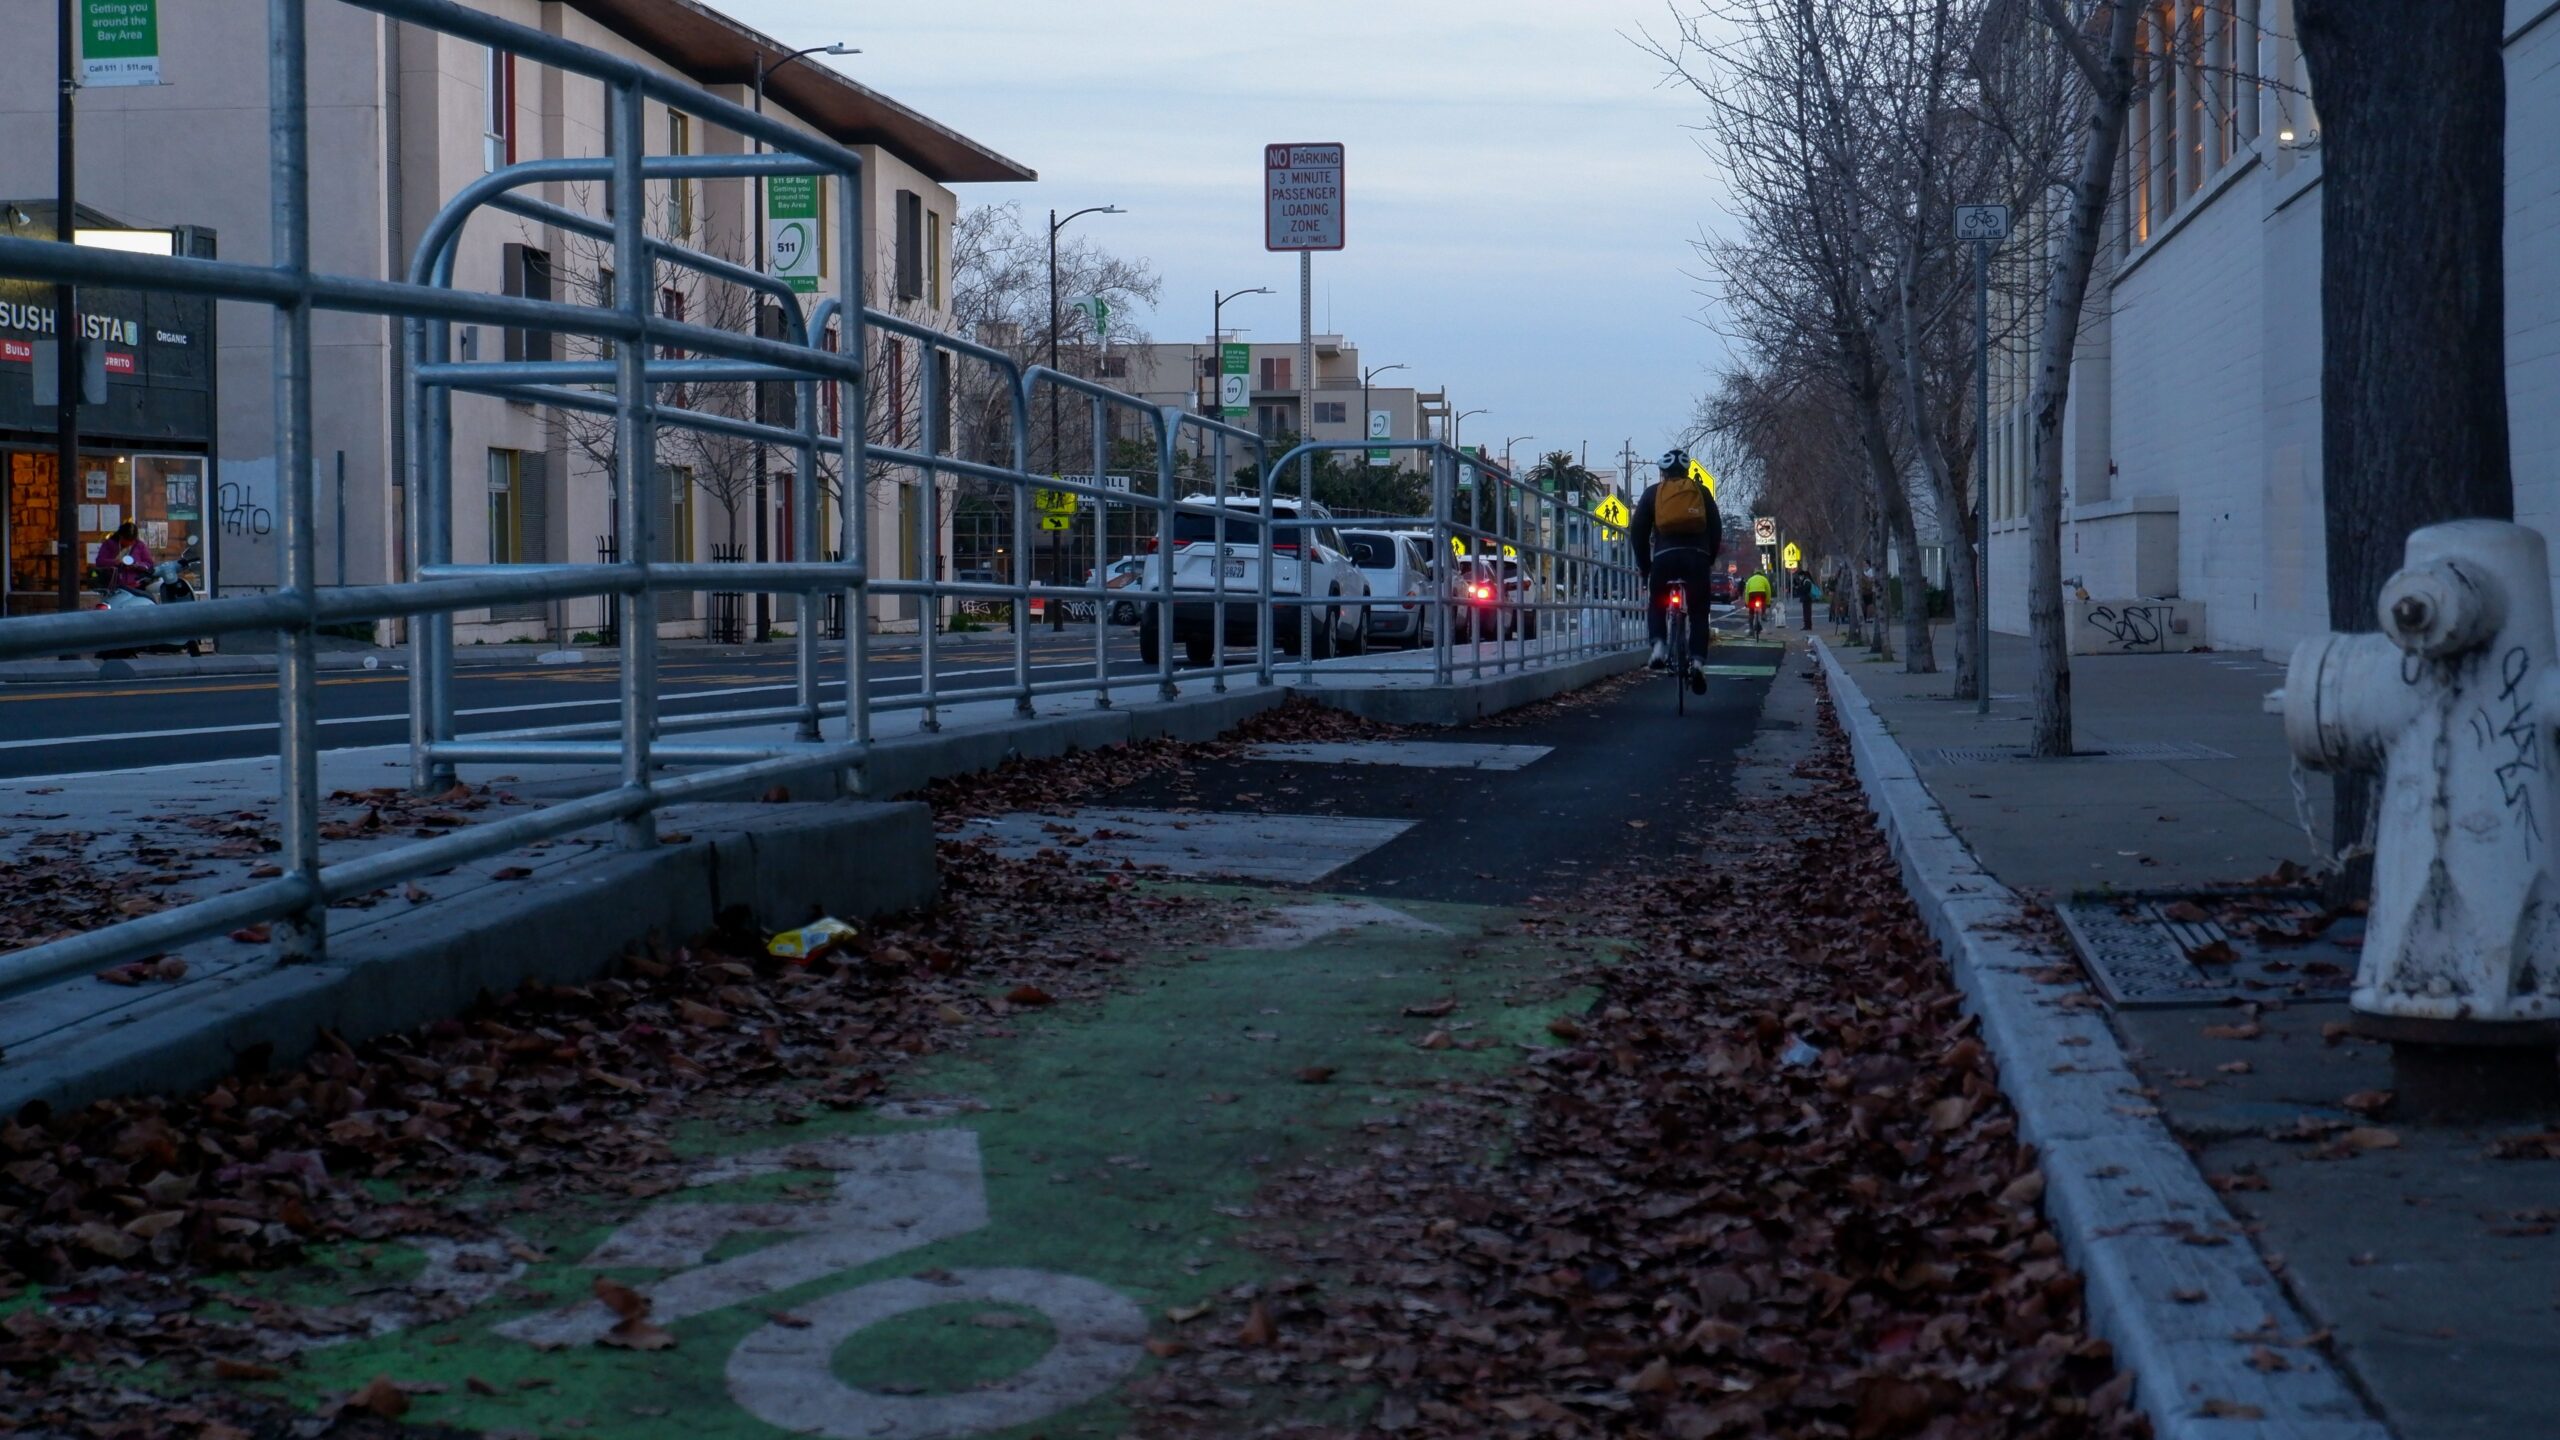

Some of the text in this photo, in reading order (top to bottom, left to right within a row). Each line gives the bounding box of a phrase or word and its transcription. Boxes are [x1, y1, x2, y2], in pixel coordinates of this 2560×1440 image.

[90, 4, 148, 15] Getting you
[92, 16, 147, 28] around the
[97, 30, 143, 42] Bay Area
[126, 64, 153, 72] 511.org
[1269, 149, 1339, 167] NO PARKING
[1279, 171, 1332, 185] 3 MINUTE
[773, 185, 797, 193] Getting
[1272, 187, 1337, 201] PASSENGER
[1282, 203, 1329, 217] LOADING
[1290, 220, 1321, 233] ZONE
[1308, 235, 1328, 243] TIMES
[777, 242, 796, 253] 511
